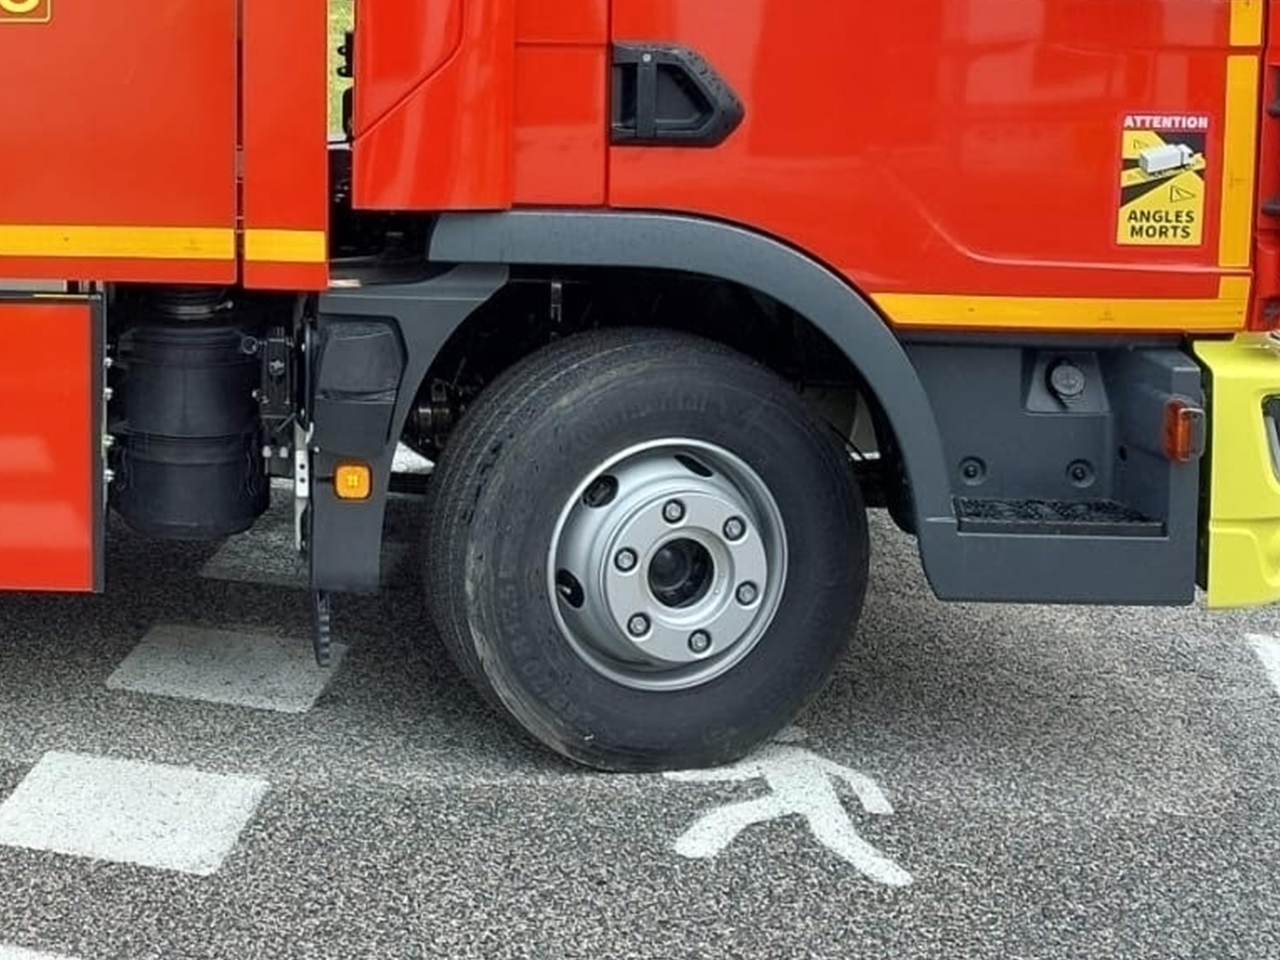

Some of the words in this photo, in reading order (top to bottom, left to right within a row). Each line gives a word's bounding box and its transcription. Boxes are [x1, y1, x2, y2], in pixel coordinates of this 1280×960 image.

[1123, 115, 1209, 129] ATTENTION
[1127, 209, 1195, 224] ANGLES
[1129, 225, 1192, 240] MORTS
